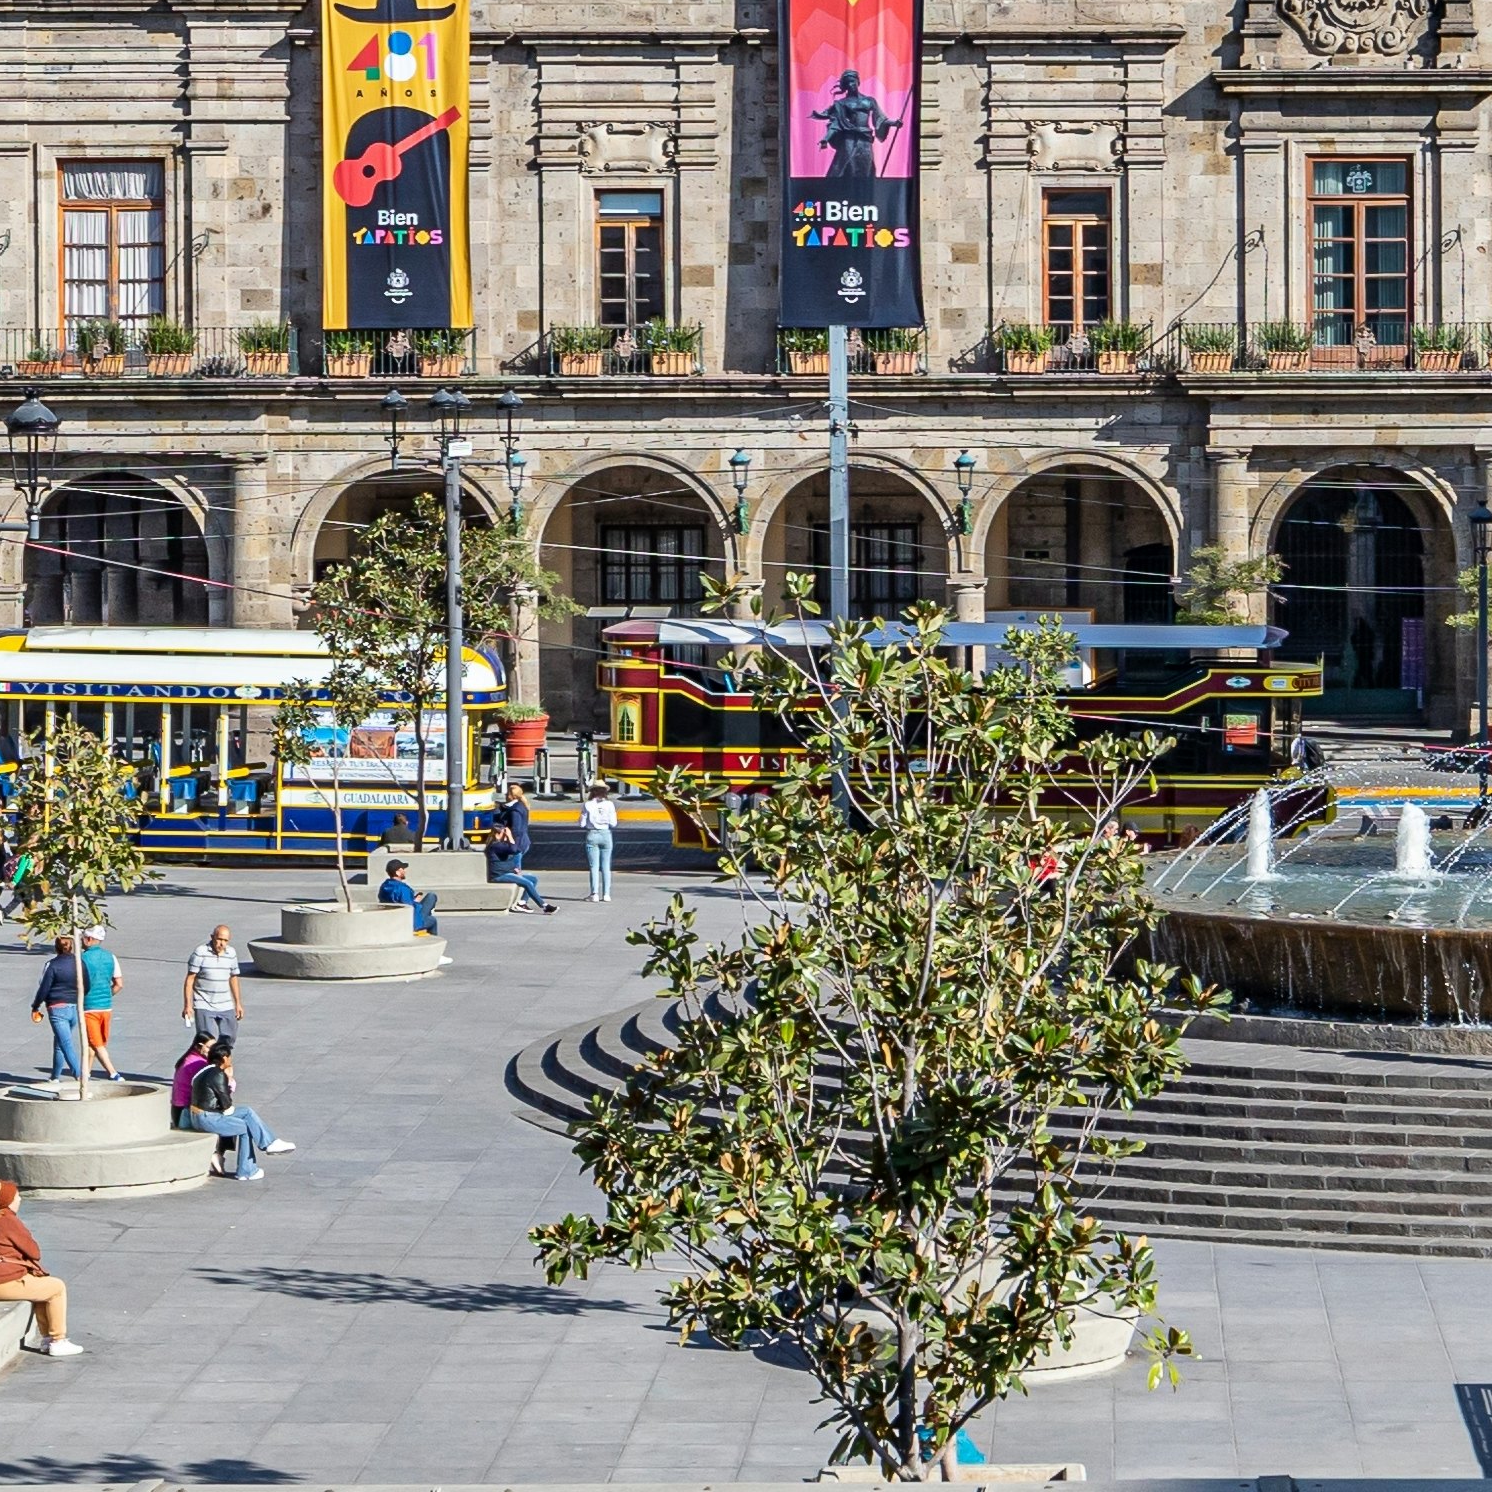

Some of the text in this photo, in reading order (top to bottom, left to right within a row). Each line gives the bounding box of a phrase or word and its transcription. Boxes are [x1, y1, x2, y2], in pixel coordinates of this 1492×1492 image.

[346, 30, 436, 82] 481
[356, 88, 437, 98] AÑOS
[377, 209, 419, 226] Bien
[792, 200, 879, 221] 481 Bien
[18, 681, 231, 699] VISITANDO
[343, 792, 409, 806] GUADALAJARA
